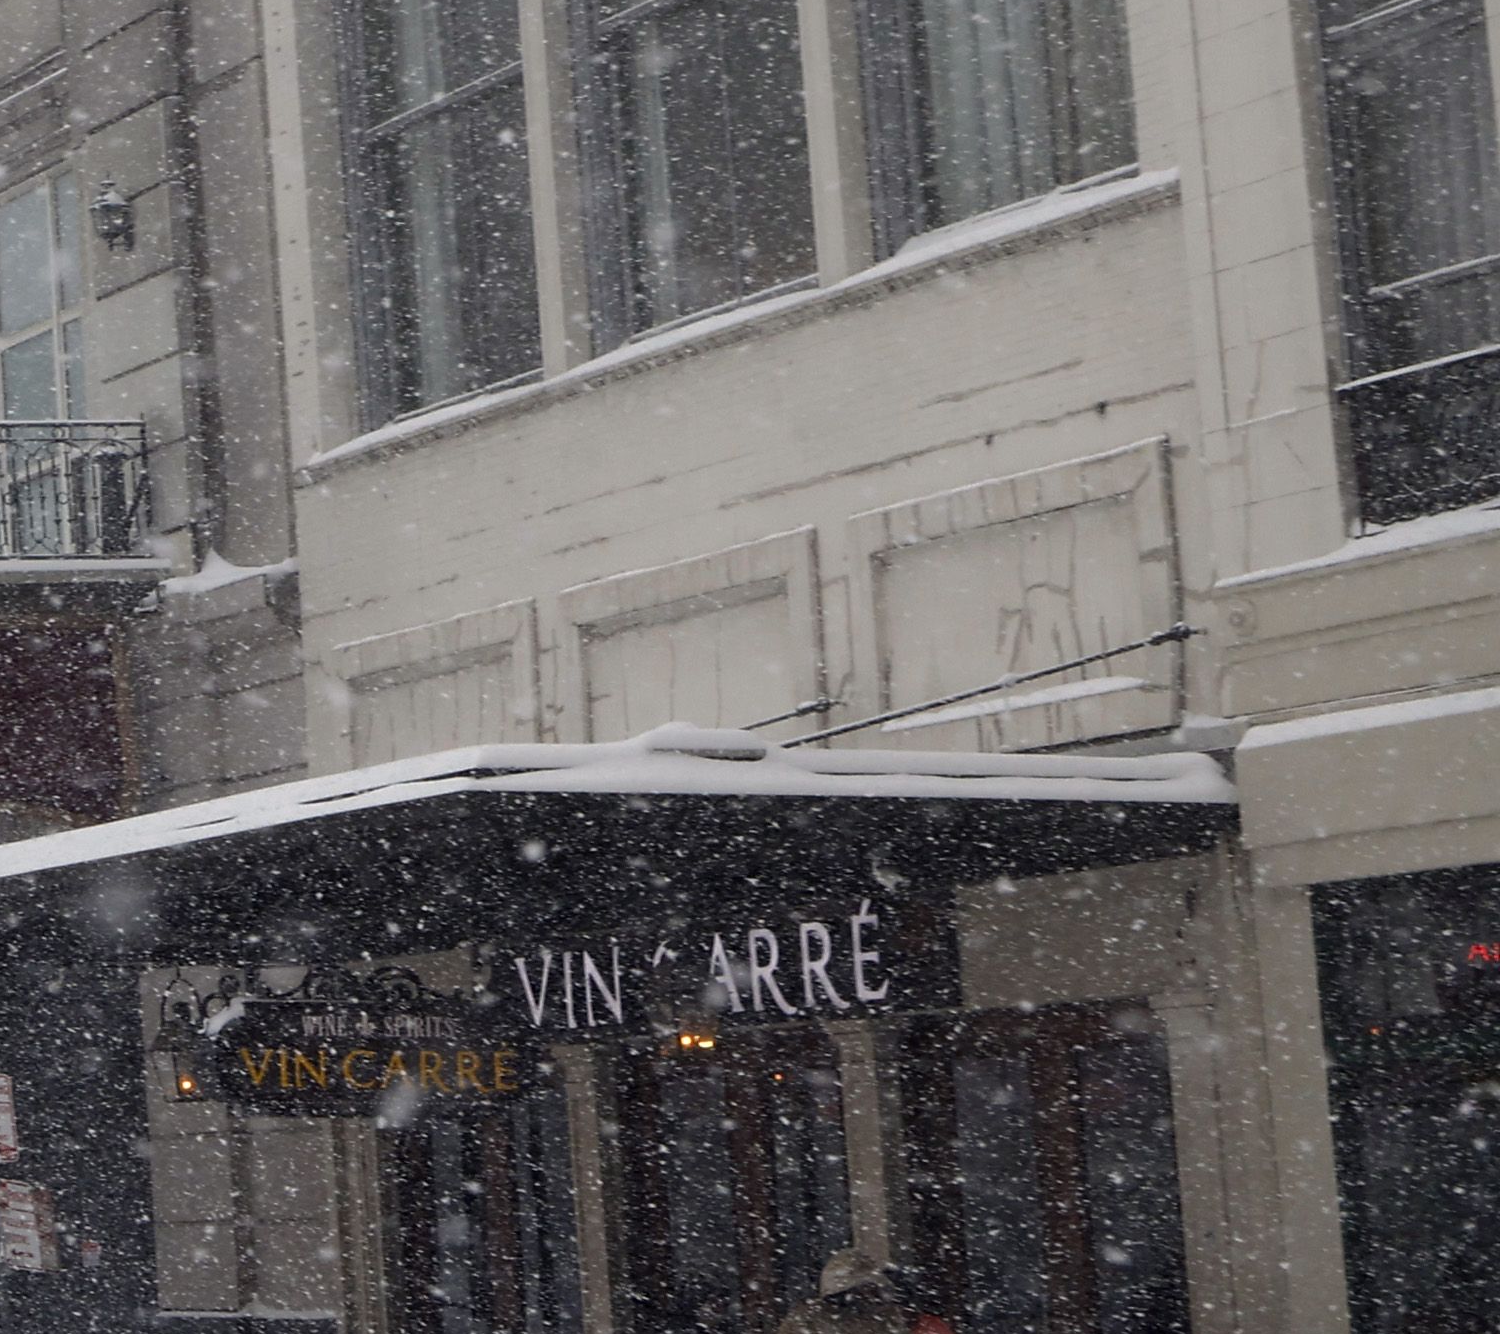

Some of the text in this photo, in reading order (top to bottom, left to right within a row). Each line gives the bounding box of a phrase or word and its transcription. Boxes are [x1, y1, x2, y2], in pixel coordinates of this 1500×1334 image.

[513, 898, 890, 1029] VIN ARRÉ
[301, 1015, 348, 1037] WINE
[383, 1015, 457, 1038] SPIRITS
[238, 1041, 519, 1093] VIN CARRÉ
